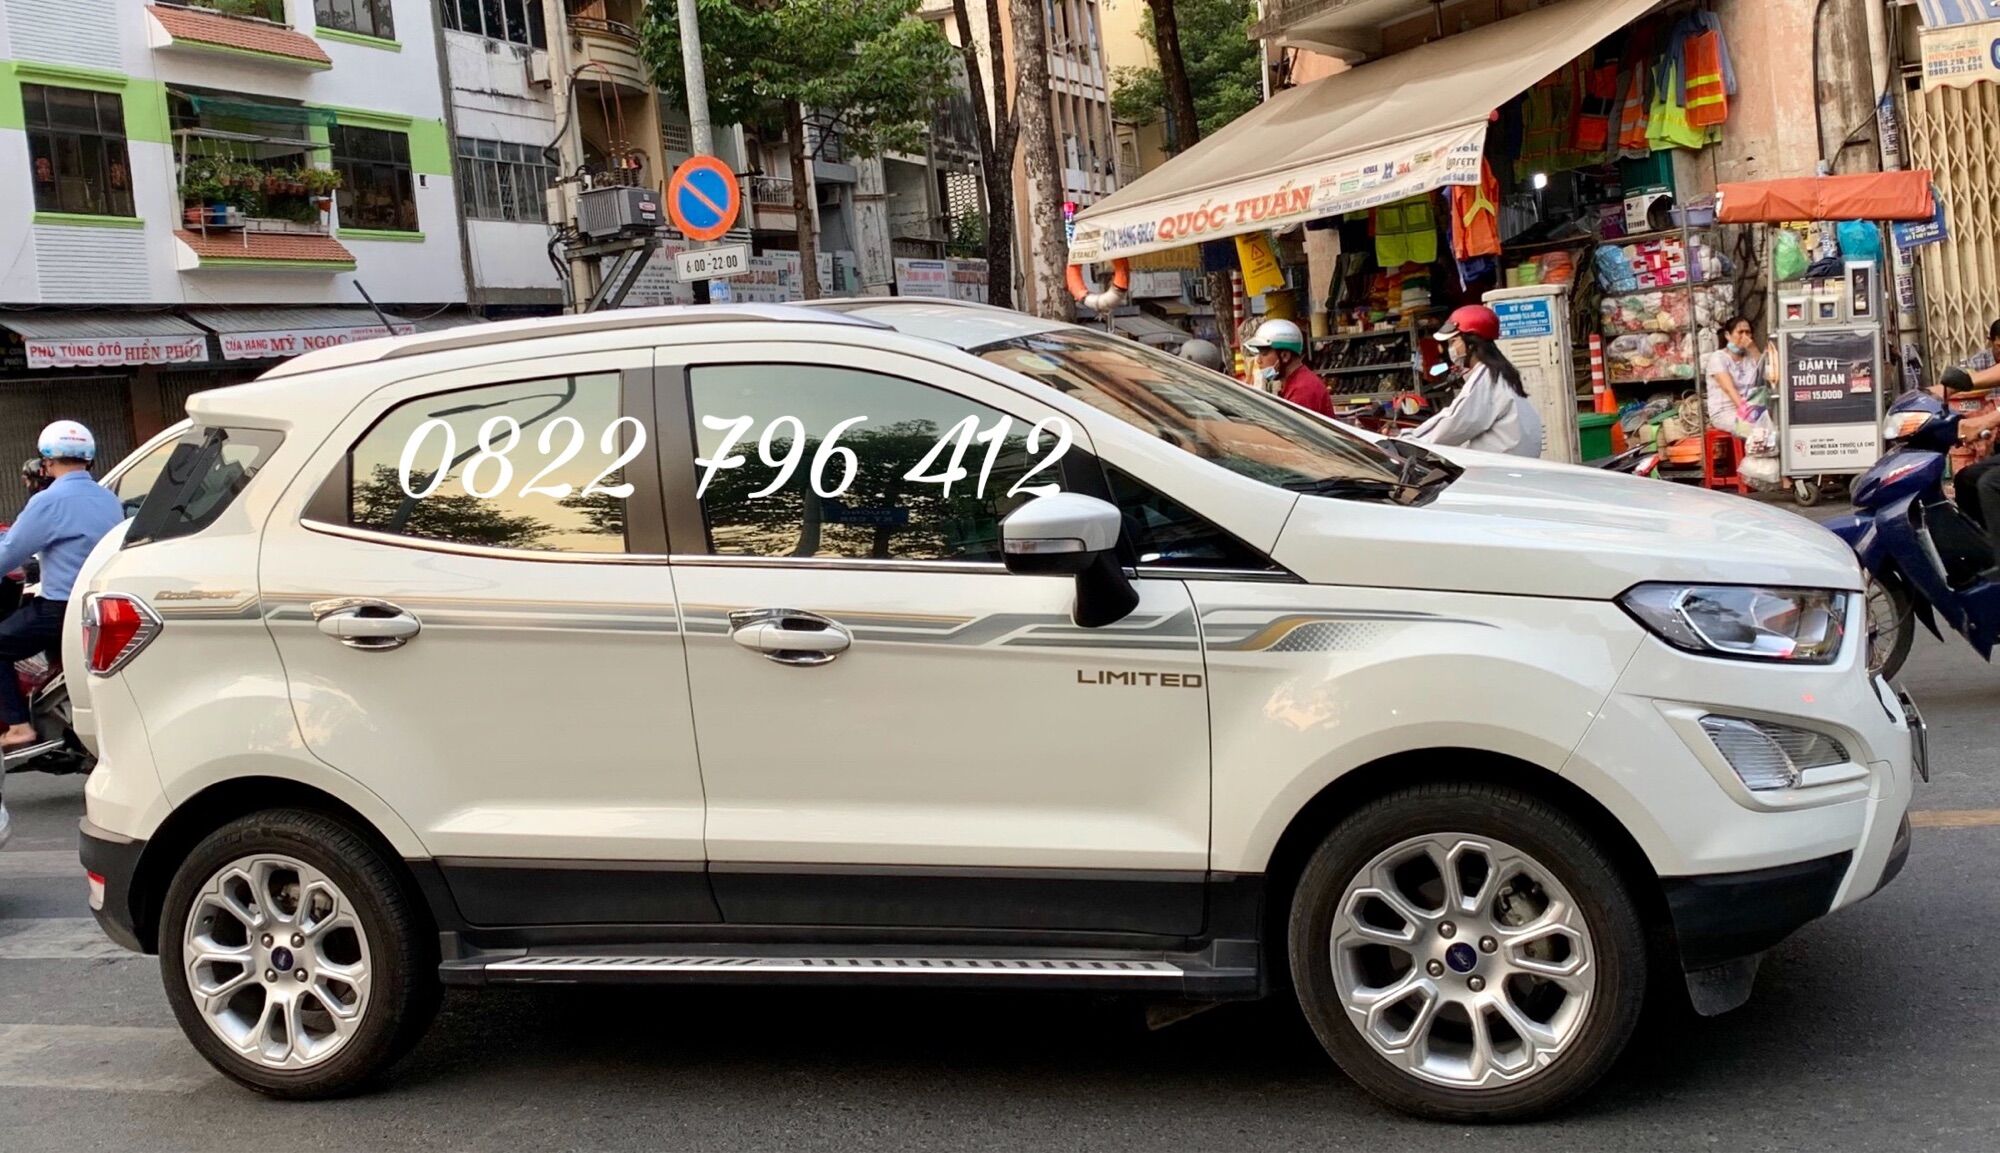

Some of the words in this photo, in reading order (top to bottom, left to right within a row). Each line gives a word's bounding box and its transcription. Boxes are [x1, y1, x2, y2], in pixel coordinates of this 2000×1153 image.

[1157, 200, 1229, 241] QUỐC
[1235, 179, 1314, 225] TUẤN
[1819, 374, 1845, 385] GIAN
[1077, 669, 1203, 688] LIMITED
